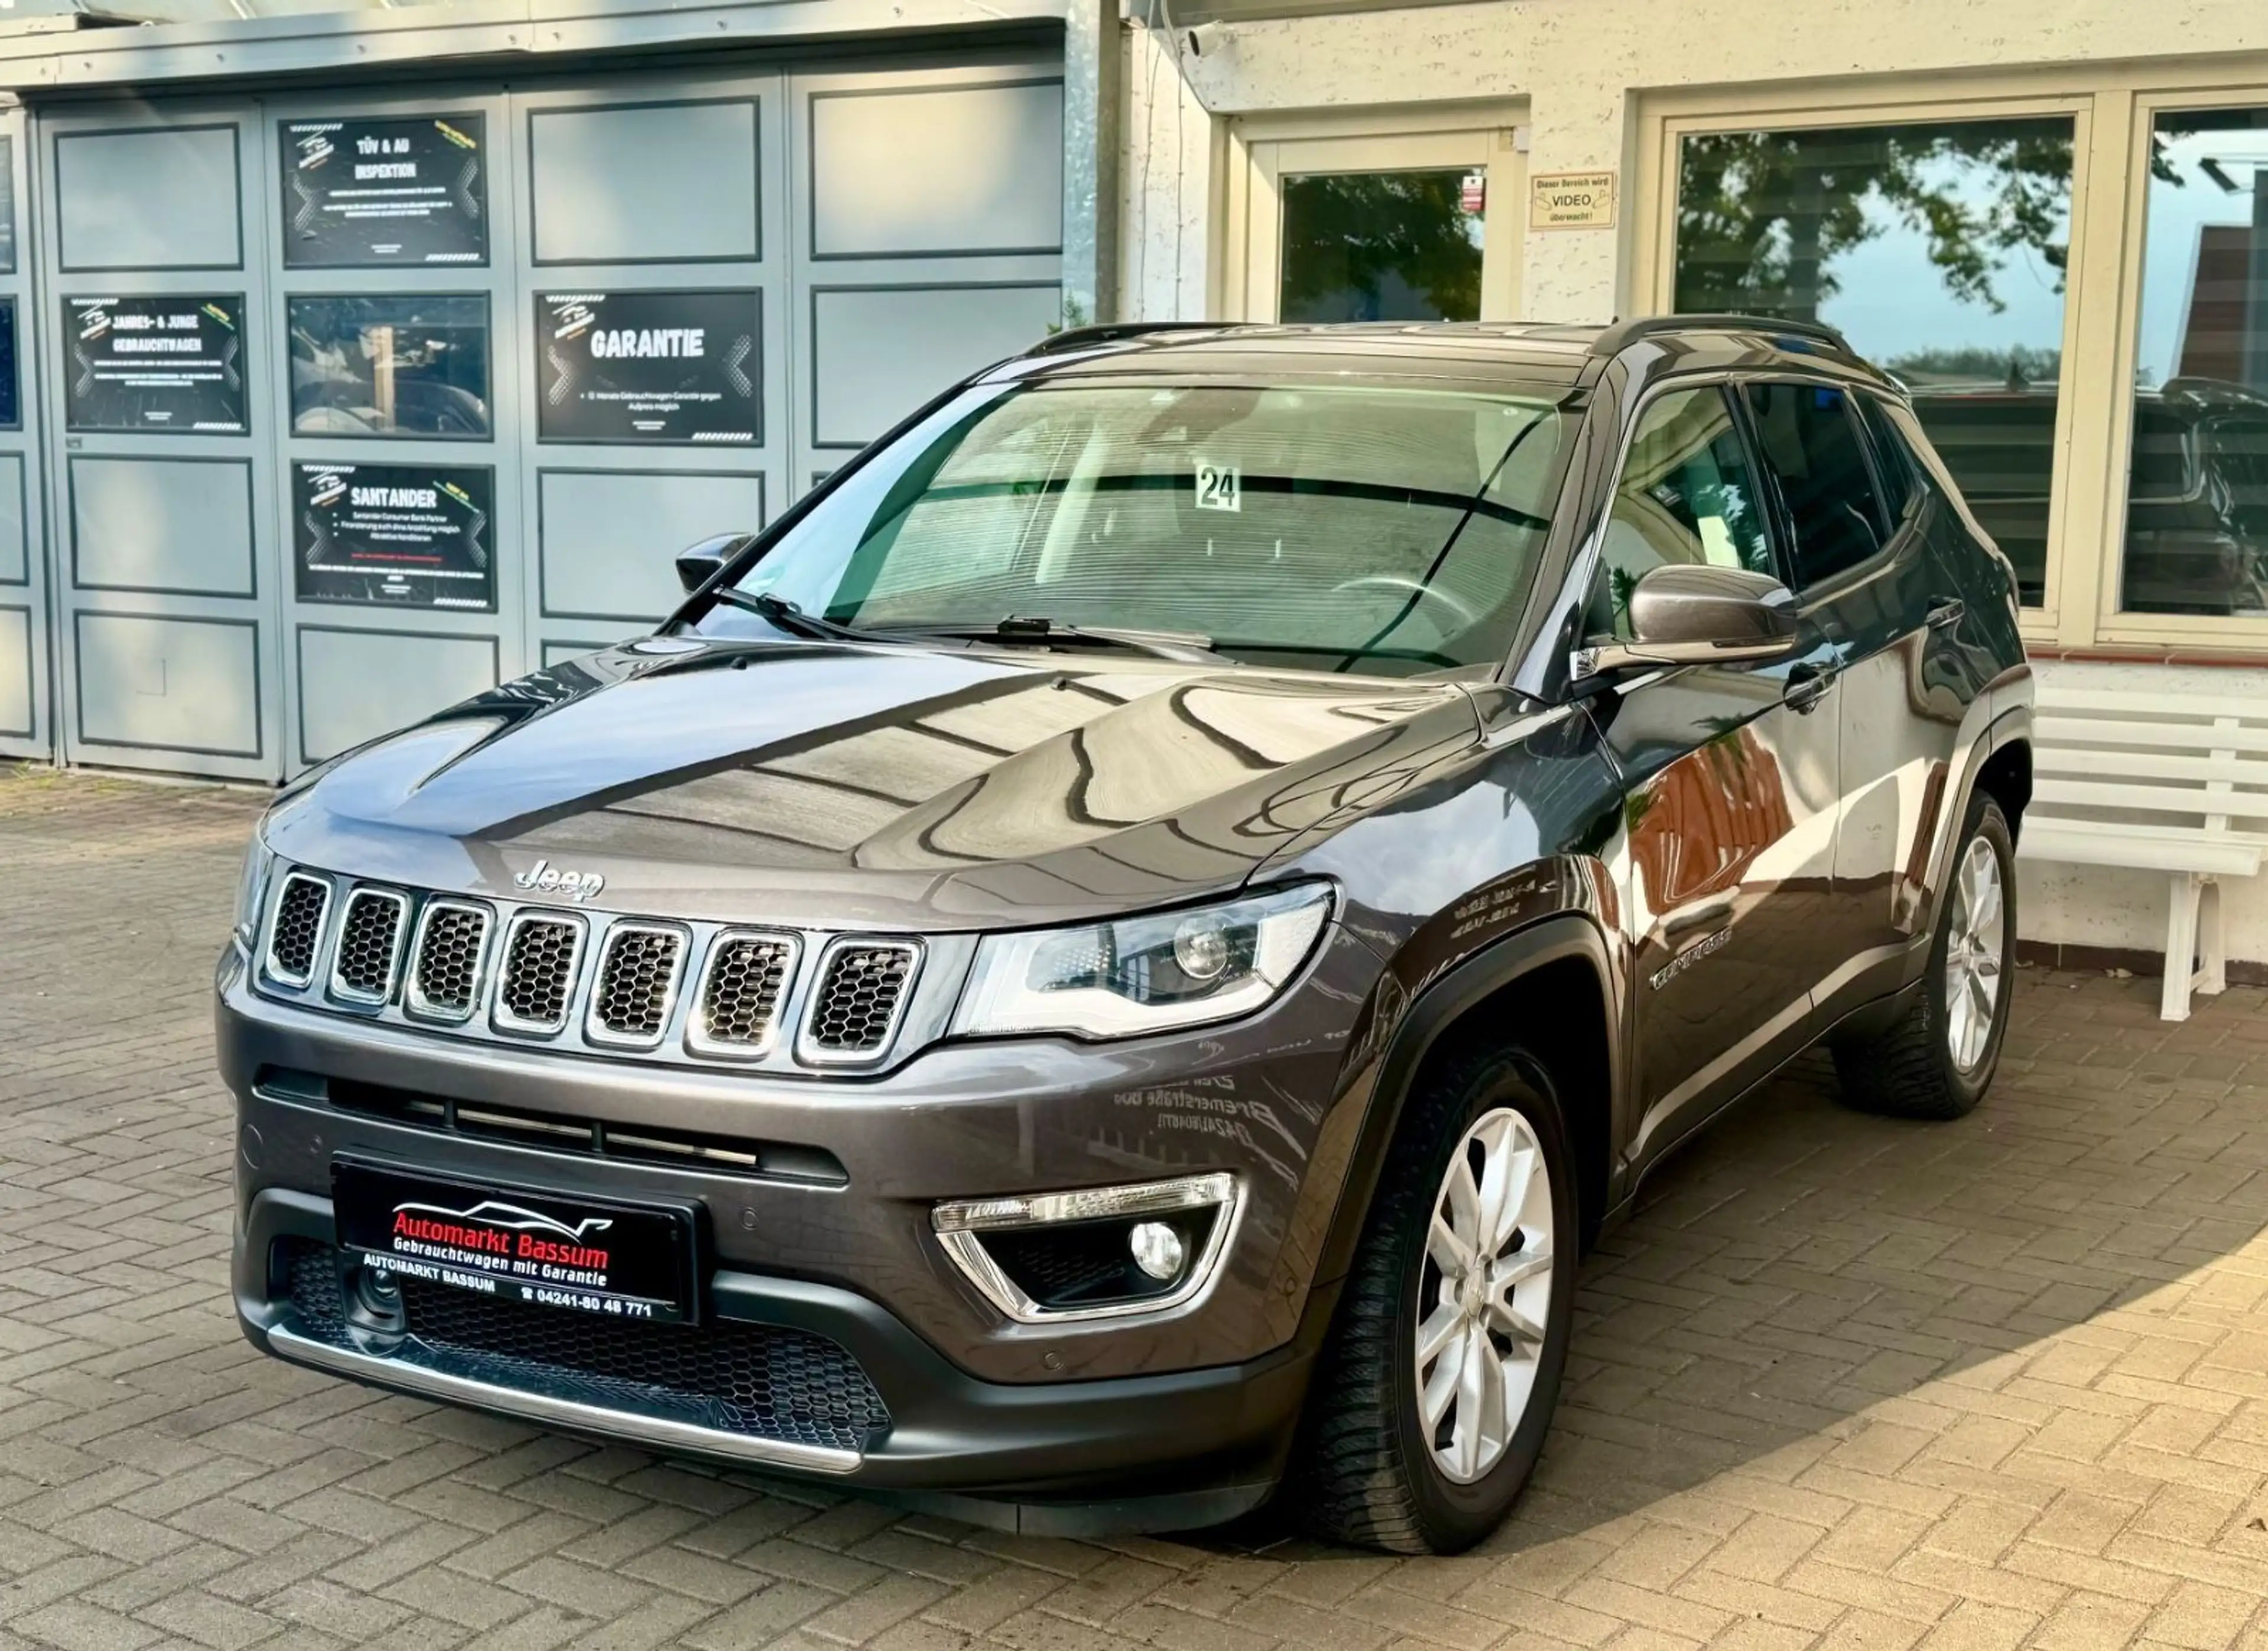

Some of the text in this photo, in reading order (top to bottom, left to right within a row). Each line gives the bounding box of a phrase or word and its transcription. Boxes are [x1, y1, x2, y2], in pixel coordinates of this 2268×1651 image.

[356, 136, 379, 154] TÜV
[355, 162, 416, 179] INSPEKTION
[1536, 177, 1608, 188] Dieser Bereich wird
[1552, 194, 1591, 207] VIDEO
[113, 337, 202, 353] GEBRAUCHTWAGEN
[591, 328, 705, 358] GARANTIE
[351, 487, 437, 508] SANTANDER
[1201, 467, 1235, 507] 24
[514, 860, 605, 903] Jeep
[393, 1212, 608, 1268] Automarkt Bassum
[393, 1236, 607, 1287] Gebrauchtwagen mit Garantie
[363, 1253, 652, 1317] AUTOMARKT BASSUM 04241-80 48 771
